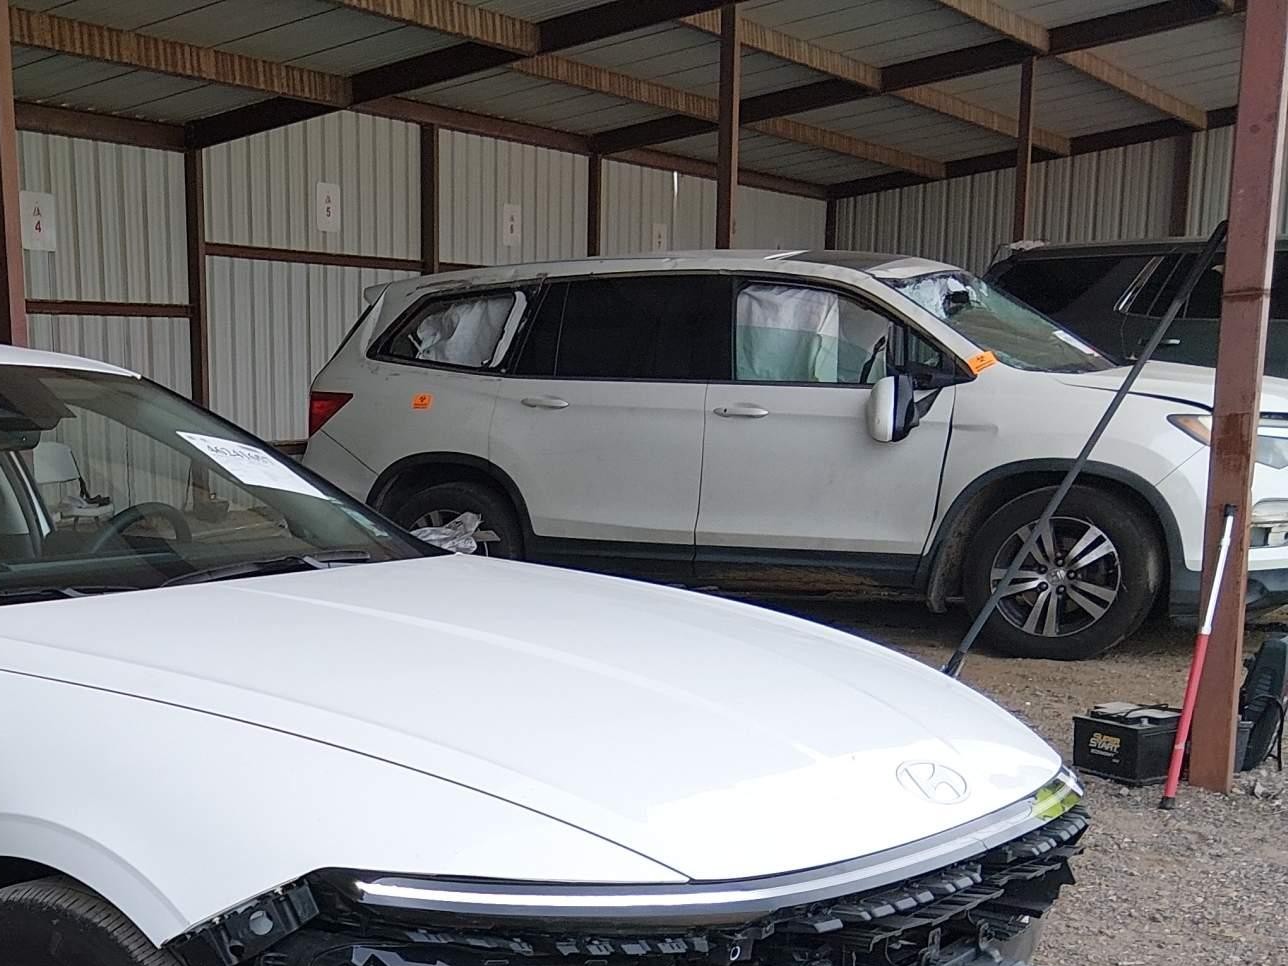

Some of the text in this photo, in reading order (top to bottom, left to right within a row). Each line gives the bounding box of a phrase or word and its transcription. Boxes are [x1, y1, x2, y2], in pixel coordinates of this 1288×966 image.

[325, 206, 331, 218] 5
[34, 220, 42, 233] 4
[1093, 733, 1120, 745] SUPER
[1089, 738, 1120, 753] START
